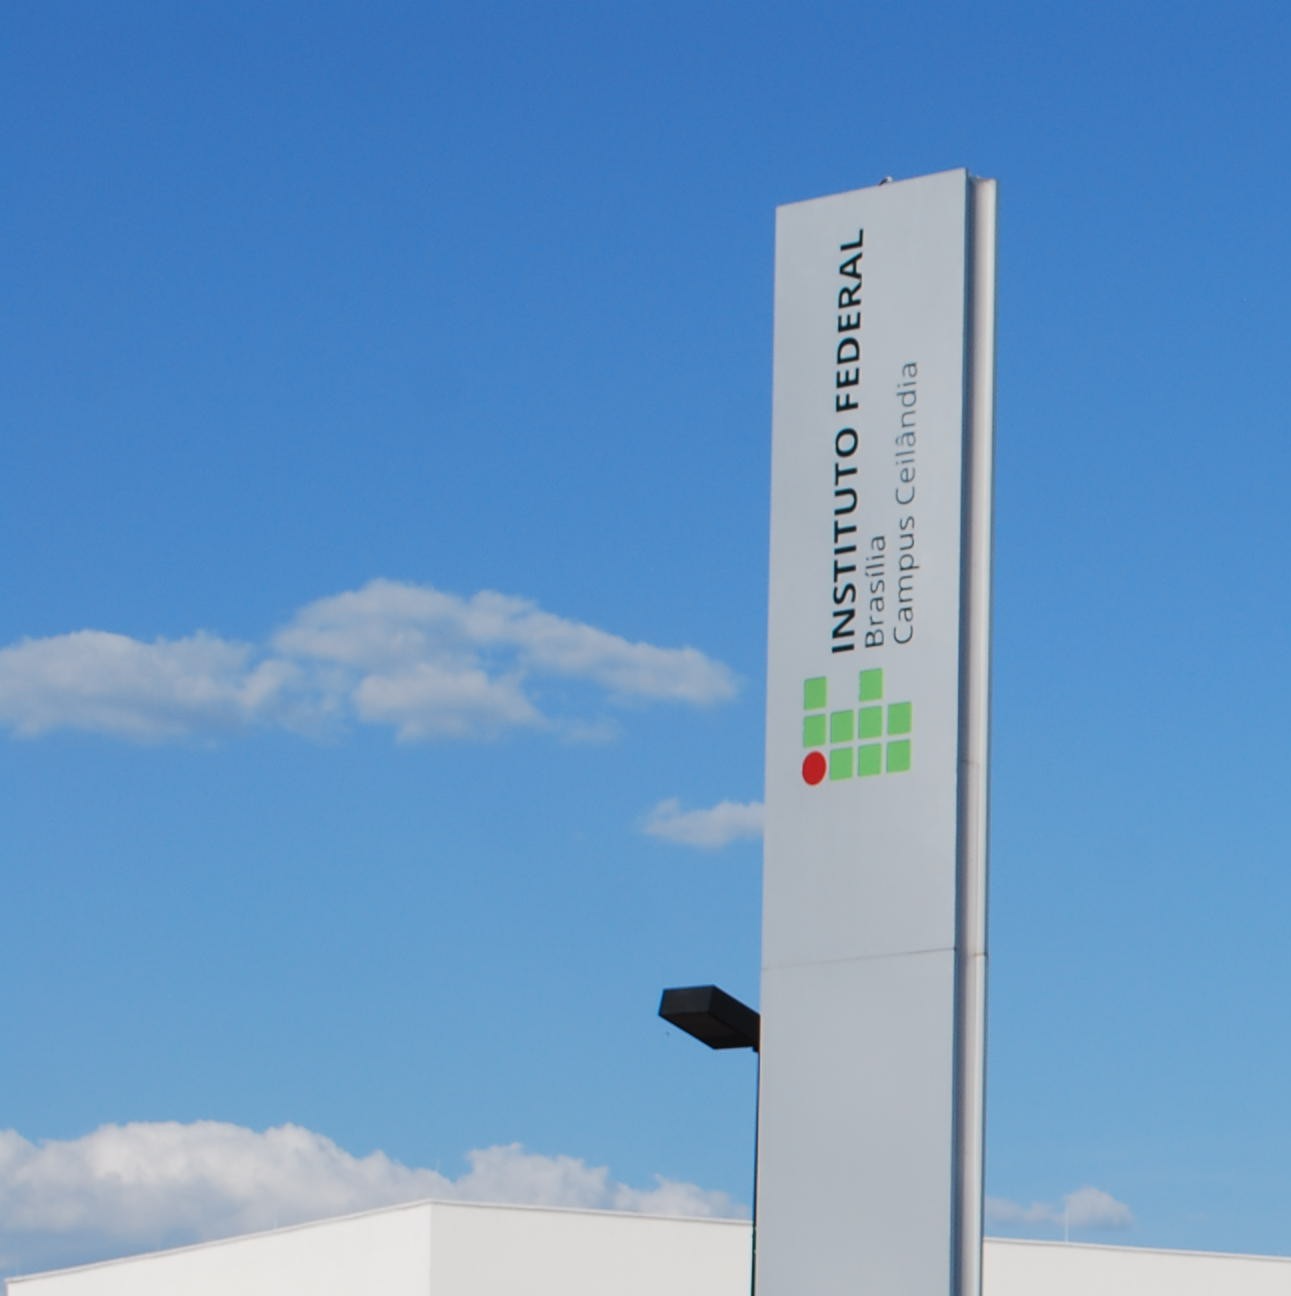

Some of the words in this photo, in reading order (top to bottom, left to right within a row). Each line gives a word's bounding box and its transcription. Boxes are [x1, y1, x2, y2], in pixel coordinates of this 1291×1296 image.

[835, 228, 864, 412] FEDERAL
[895, 361, 918, 505] Ceilândia
[832, 427, 859, 654] INSTITUTO
[865, 535, 886, 649] Brasília
[893, 515, 920, 645] Campus
